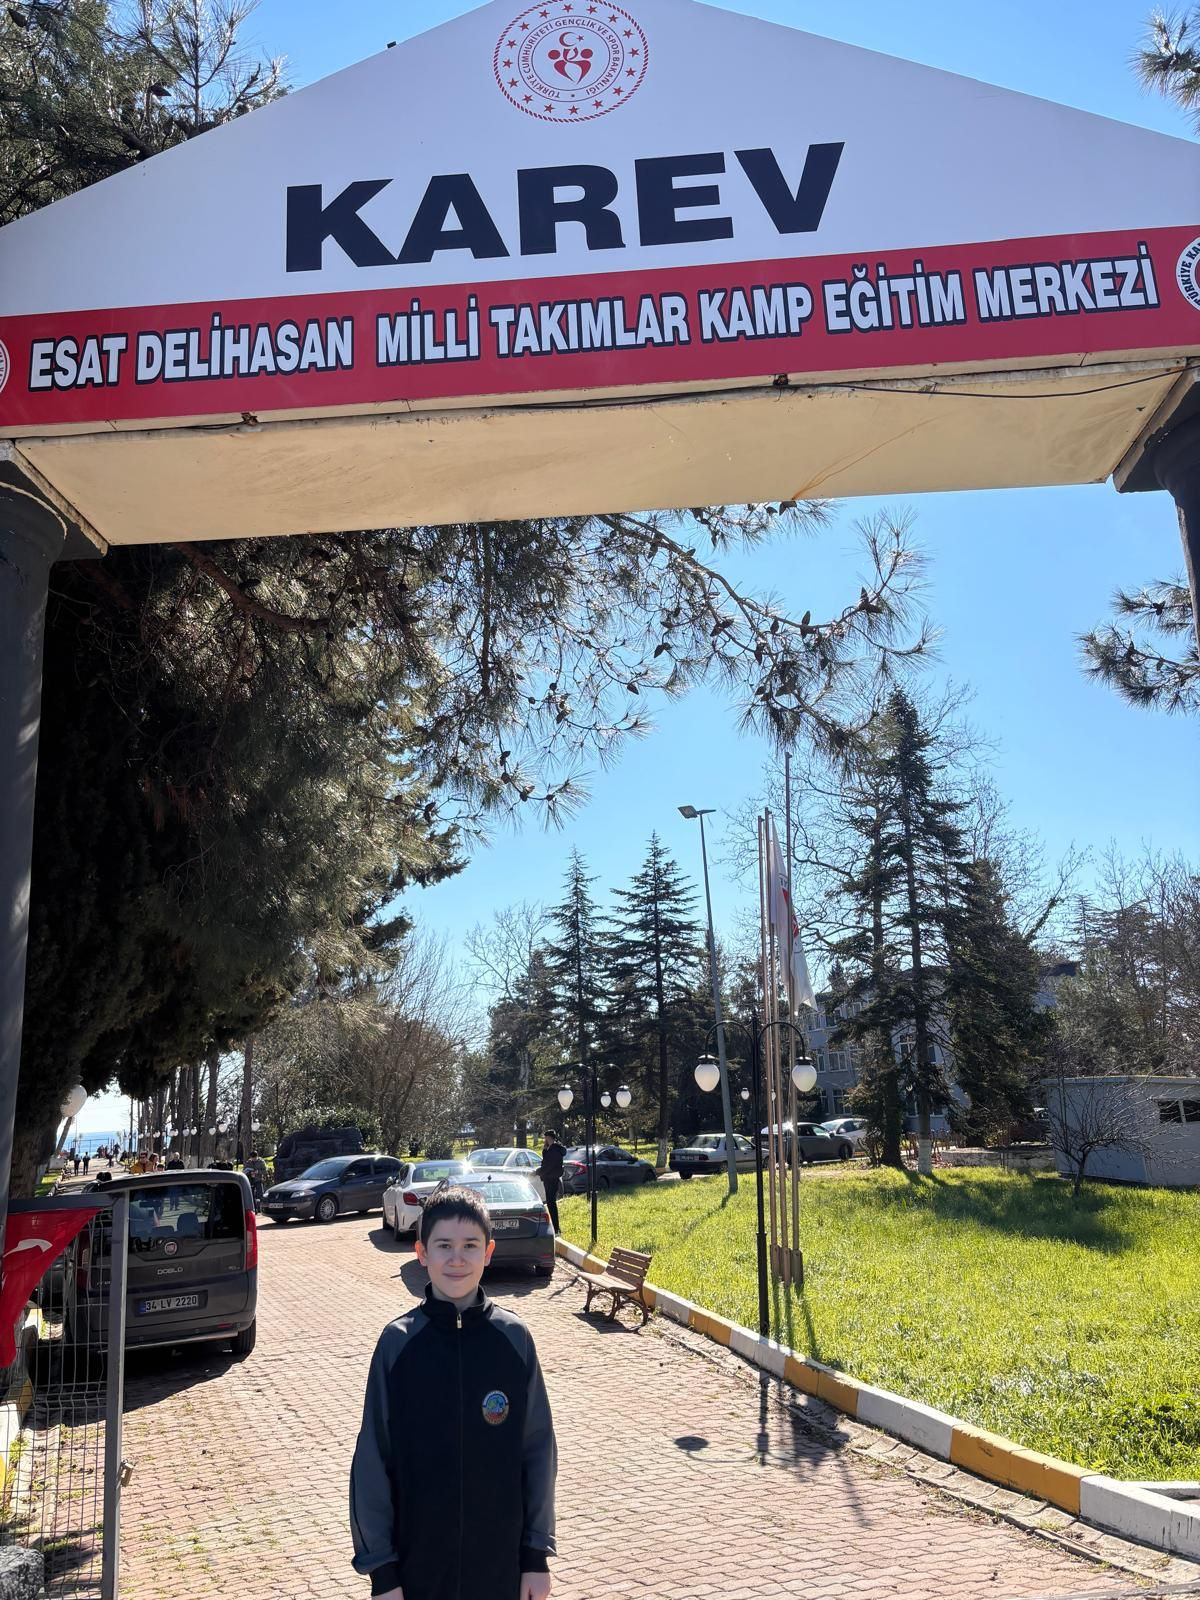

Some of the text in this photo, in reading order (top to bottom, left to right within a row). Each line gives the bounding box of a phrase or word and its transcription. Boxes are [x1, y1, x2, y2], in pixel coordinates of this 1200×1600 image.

[521, 18, 621, 99] TÜRKİYE CUMHURİYETİ GENÇLİK VE SPOR BAKANLIĞI
[286, 142, 846, 272] KAREV
[29, 336, 128, 390] ESAT
[136, 313, 353, 383] DELİHASAN
[376, 295, 480, 365] MİLLİ
[490, 295, 690, 357] TAKIMLAR
[698, 284, 813, 341] KAMP
[823, 263, 966, 332] EĞİTİM
[973, 244, 1160, 321] MERKEZİ
[145, 1296, 197, 1311] 34 LV 2220
[156, 1266, 184, 1275] DOBLO
